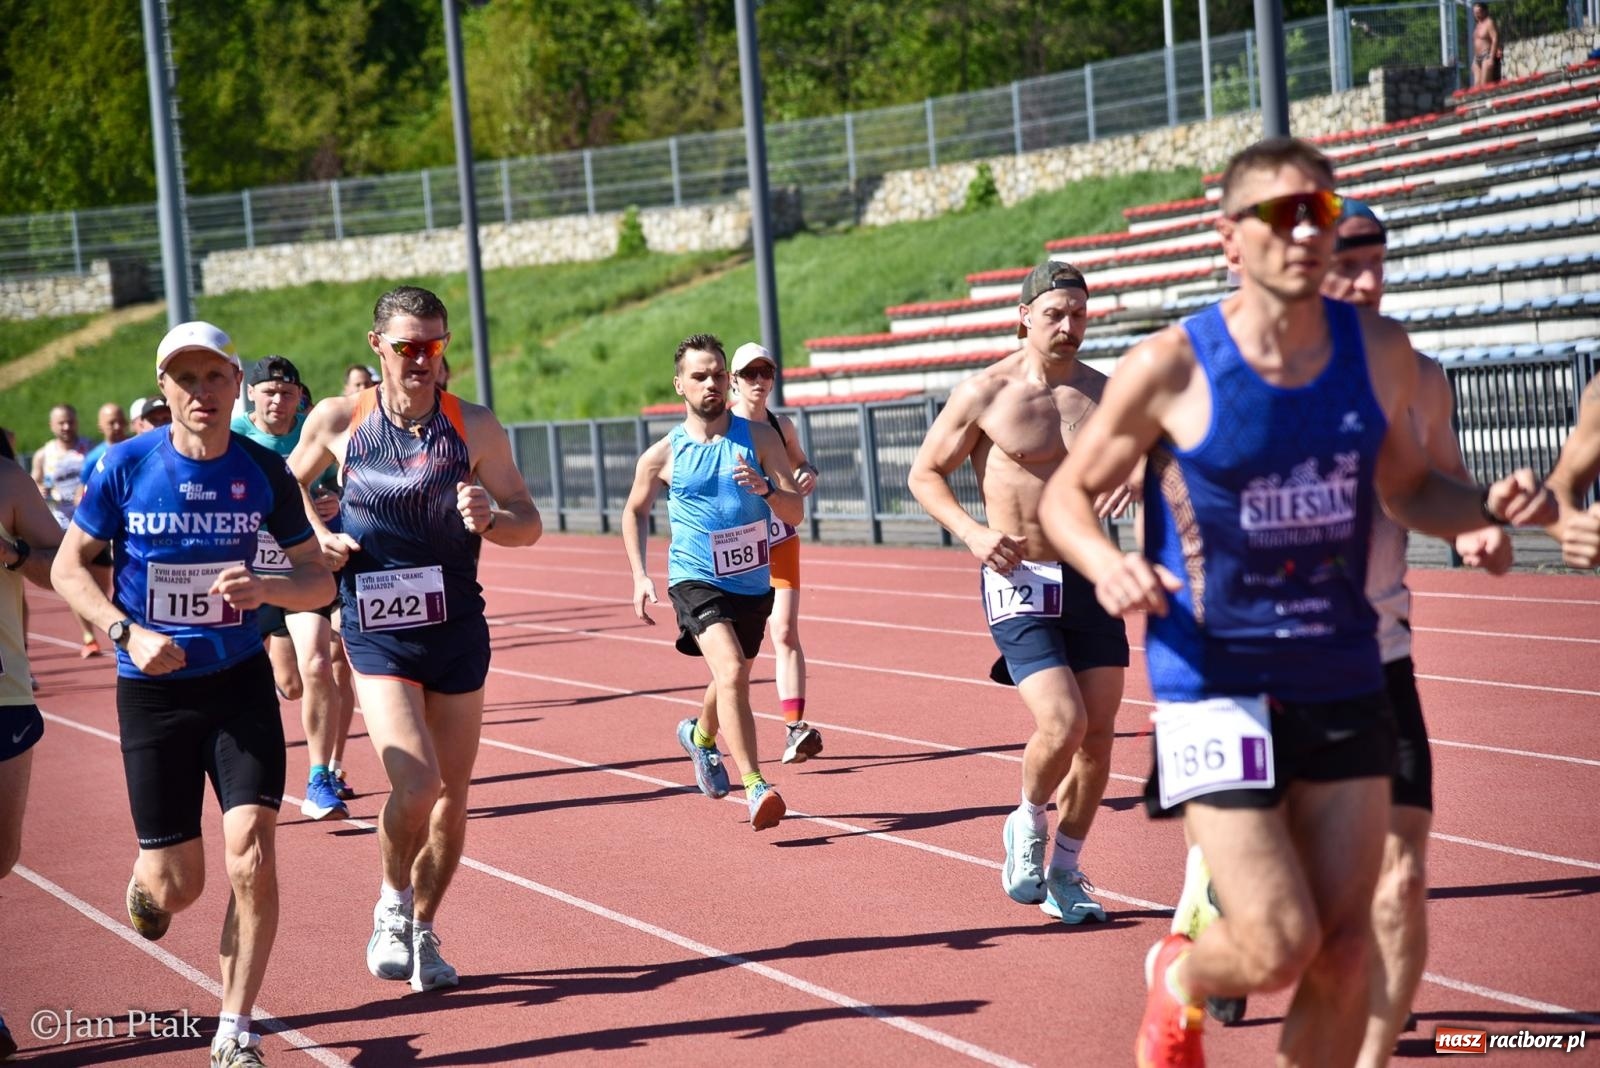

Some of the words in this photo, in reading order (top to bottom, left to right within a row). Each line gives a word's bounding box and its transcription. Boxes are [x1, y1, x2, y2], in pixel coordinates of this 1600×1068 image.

[127, 511, 262, 535] RUNNERS
[213, 538, 241, 546] TEAM
[260, 549, 287, 565] 127
[723, 545, 754, 568] 158
[154, 576, 191, 584] 3MAJA2026
[155, 568, 170, 576] XVIII
[171, 569, 187, 577] BIEG
[188, 569, 200, 577] BEZ
[362, 576, 375, 584] XVIII
[376, 575, 389, 583] BIEG
[362, 583, 395, 591] 3MAJA2026
[997, 584, 1034, 609] 172
[168, 592, 209, 617] 115
[370, 595, 422, 621] 242
[1173, 738, 1226, 778] 186
